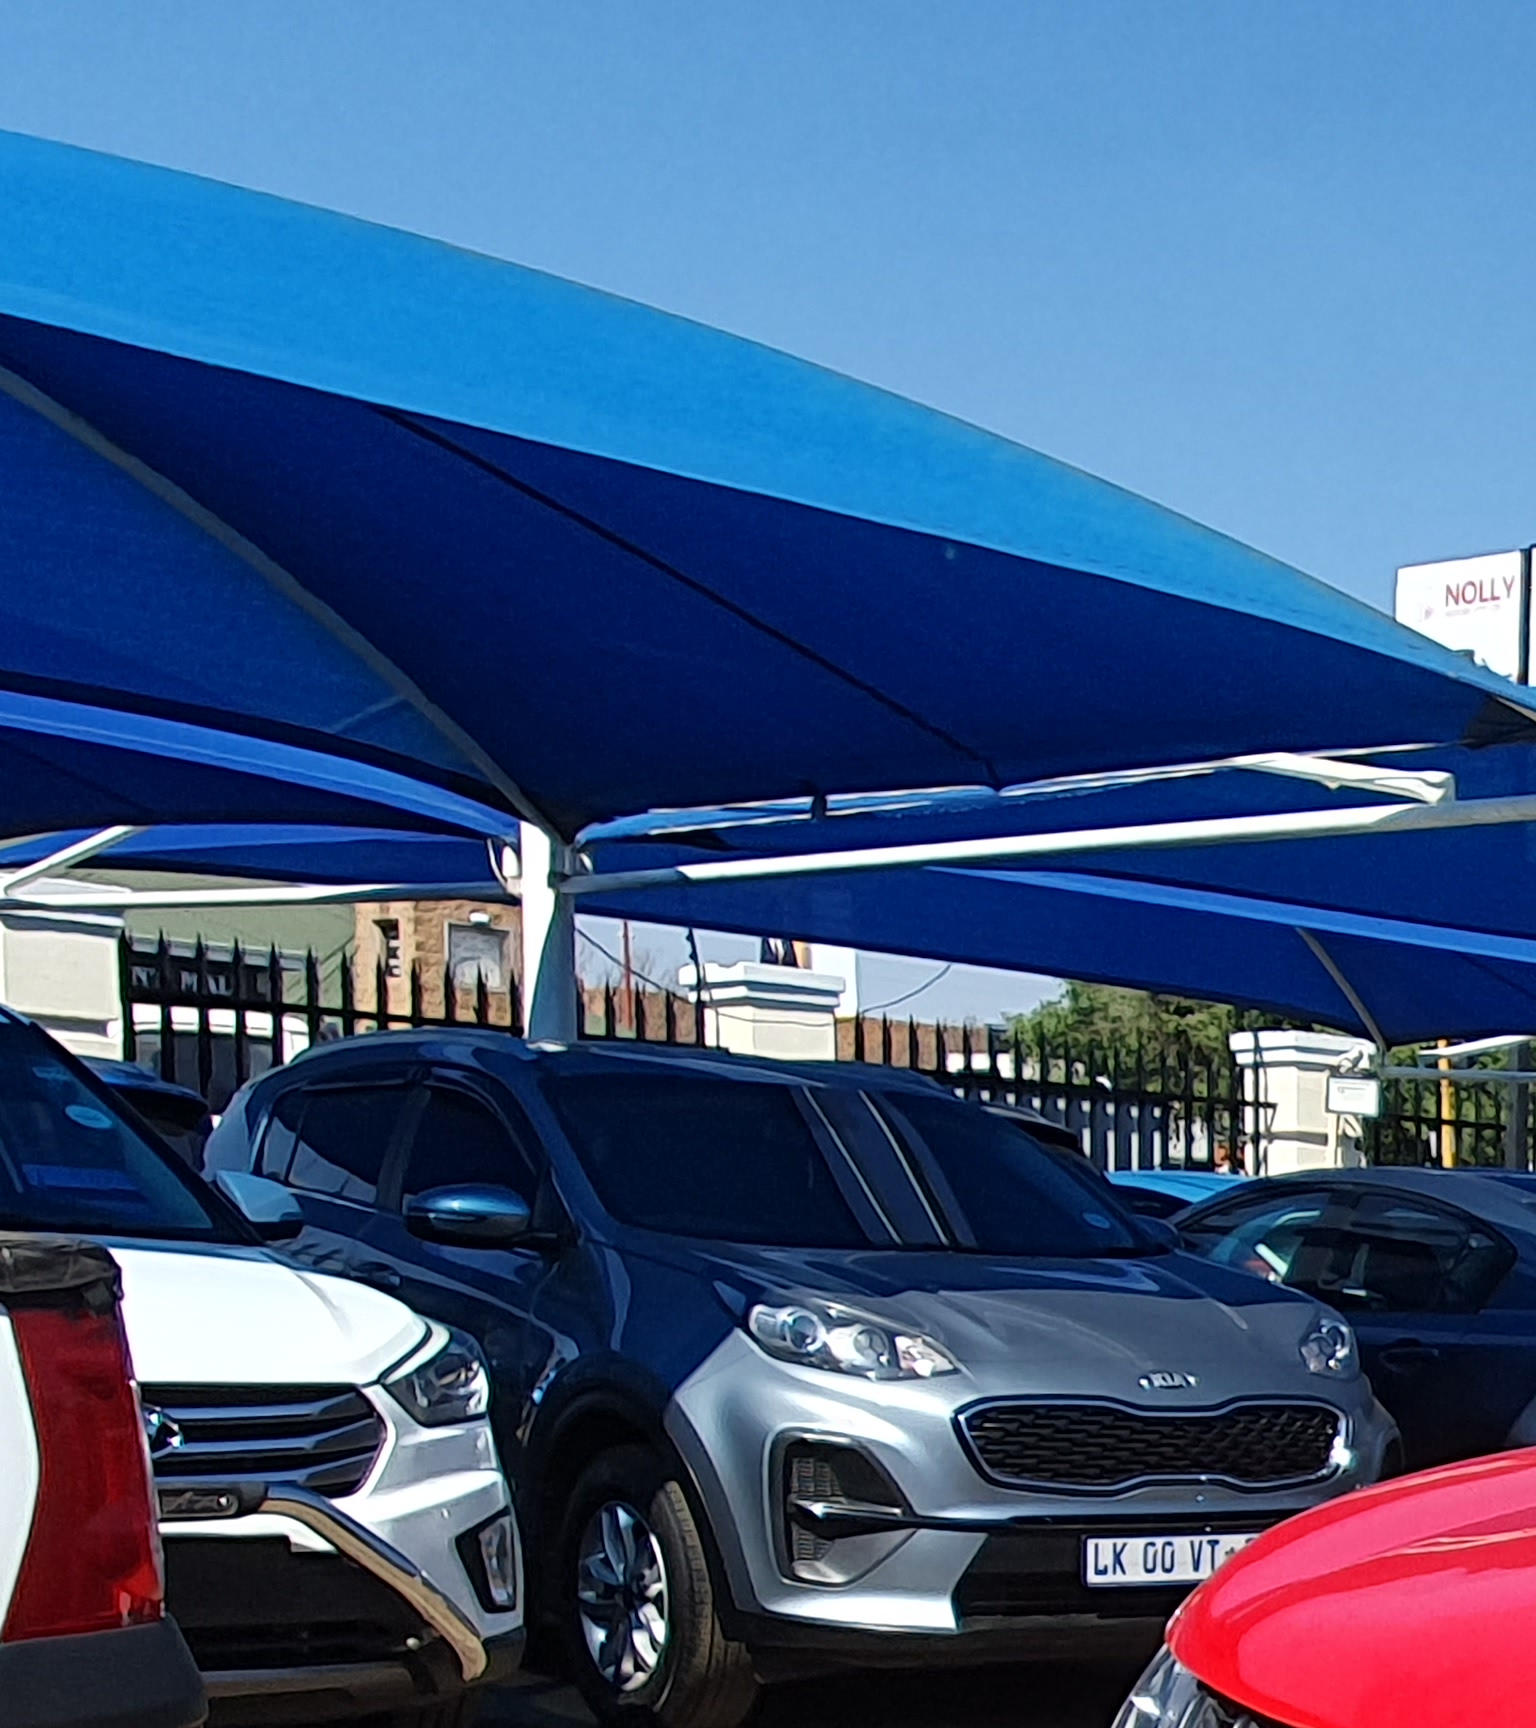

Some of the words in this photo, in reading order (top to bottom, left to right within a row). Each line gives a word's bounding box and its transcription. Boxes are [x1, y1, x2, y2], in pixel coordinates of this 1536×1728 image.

[1445, 575, 1515, 608] NOLLY
[1094, 1541, 1127, 1575] LK
[1190, 1539, 1220, 1573] VT
